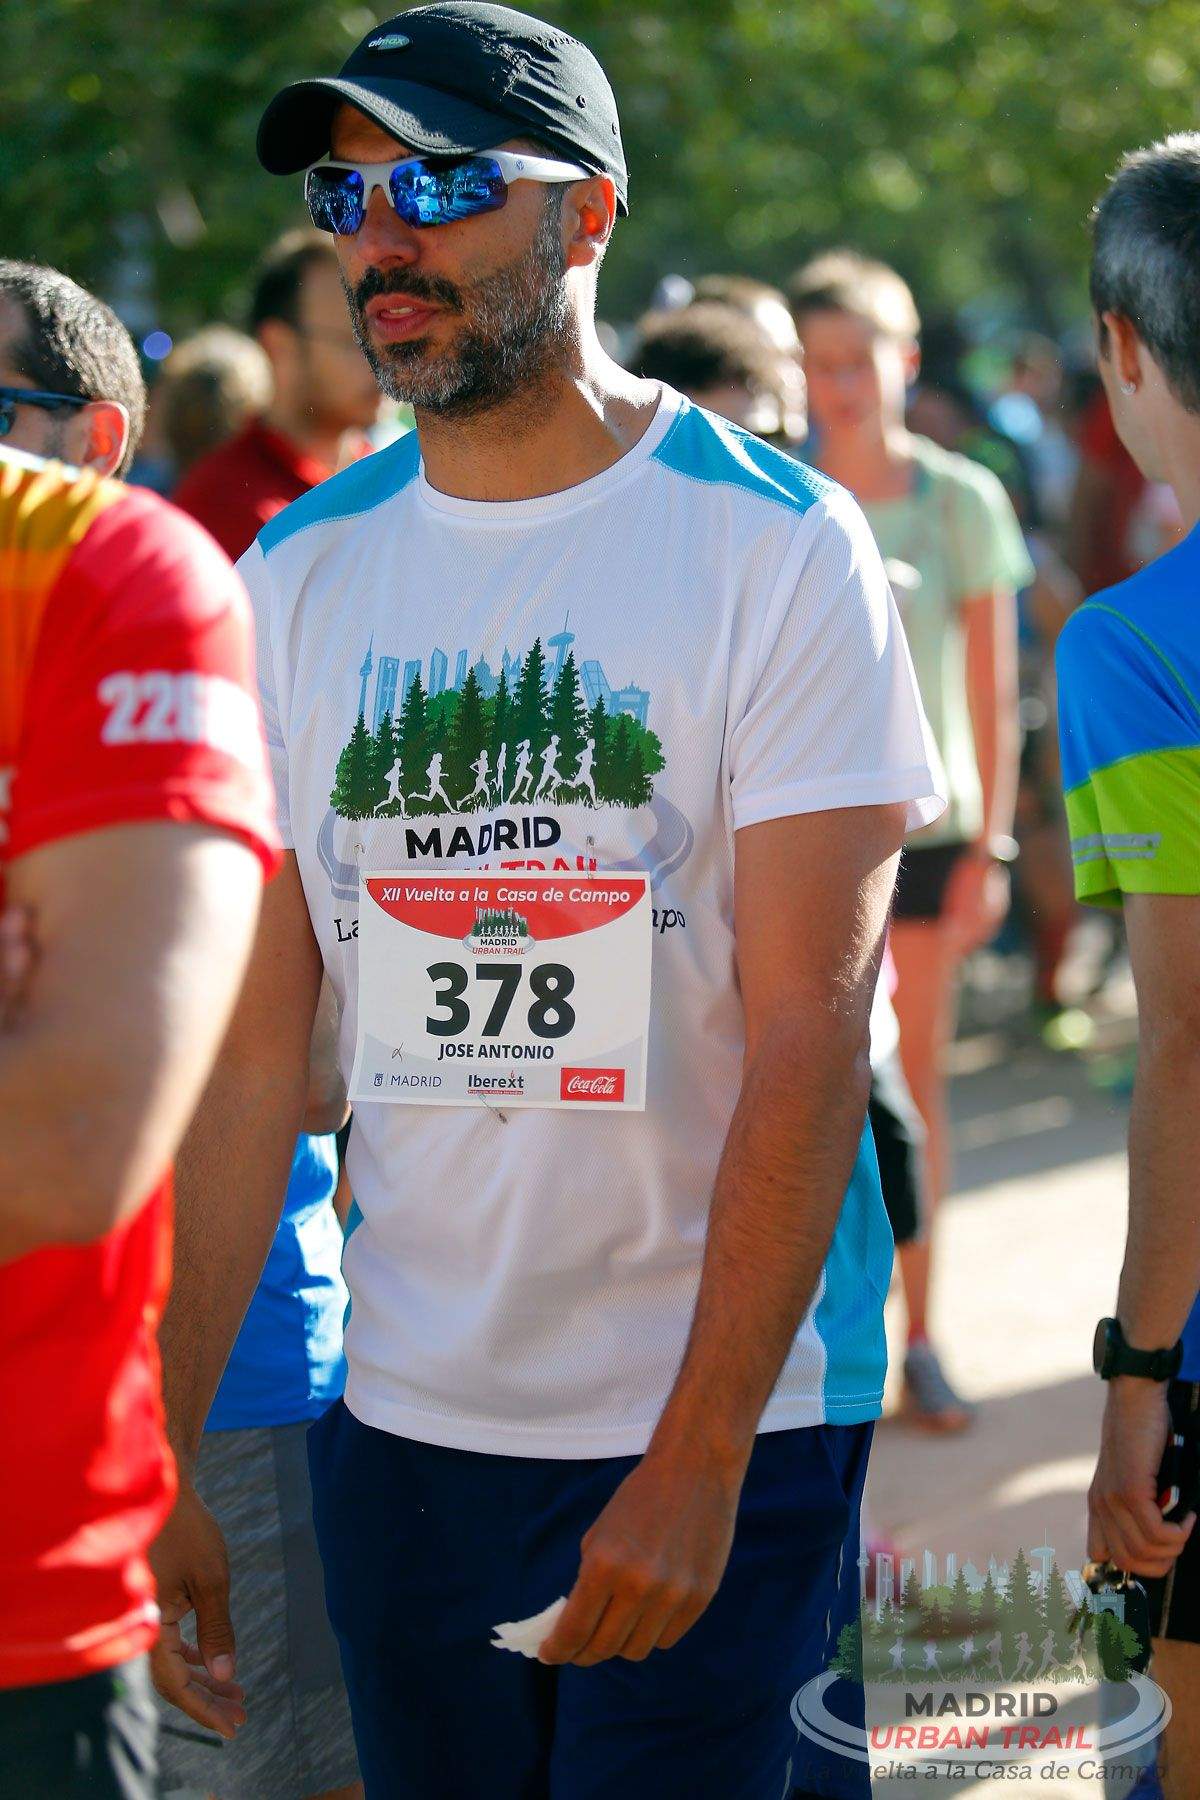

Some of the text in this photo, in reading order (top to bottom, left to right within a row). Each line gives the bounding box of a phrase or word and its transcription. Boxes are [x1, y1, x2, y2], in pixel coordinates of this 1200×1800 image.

[405, 816, 561, 859] MADRID
[381, 887, 630, 906] XII Vuelta a la Casa de Campo
[480, 938, 517, 946] MADRID
[472, 947, 526, 955] URBAN TRAIL
[425, 961, 576, 1039] 378
[437, 1043, 555, 1061] JOSE ANTONIO
[391, 1075, 442, 1088] MADRID
[468, 1074, 524, 1088] Iberext
